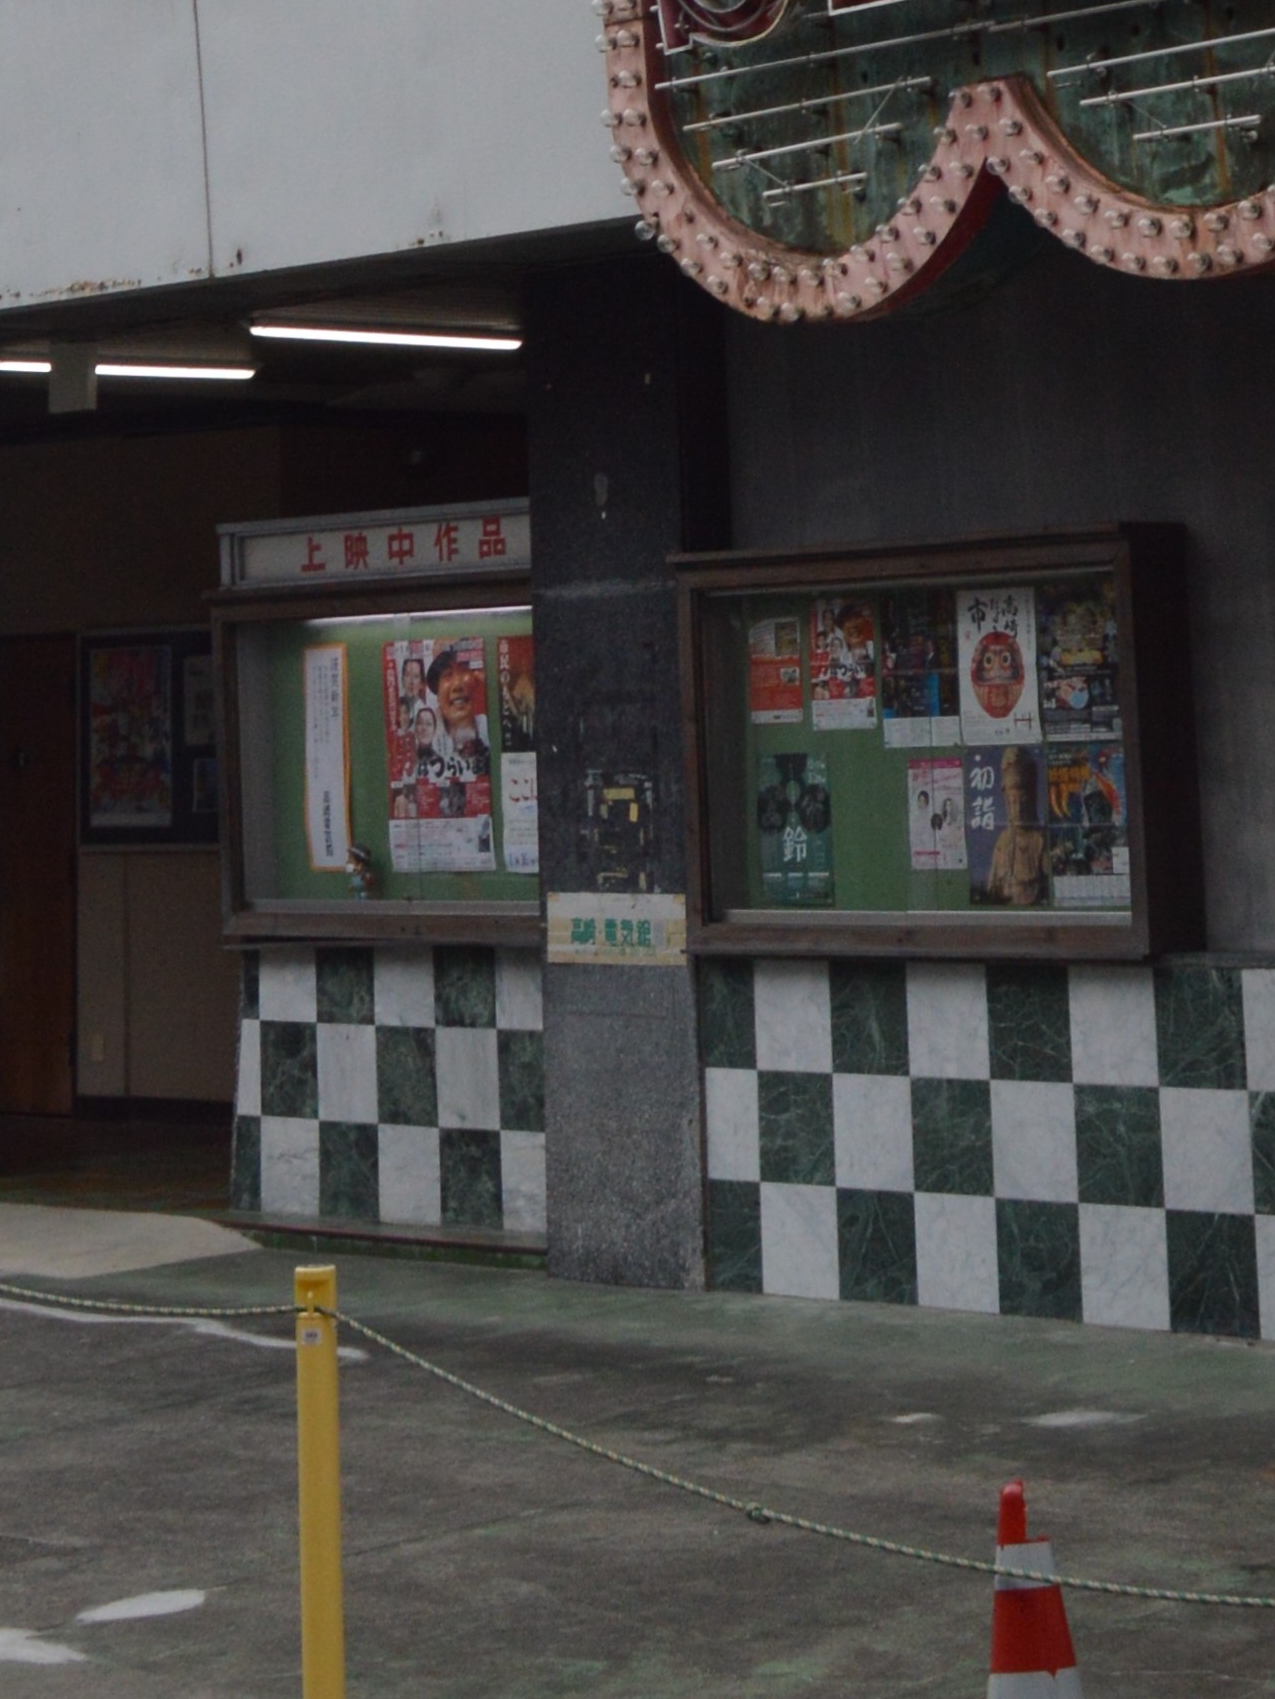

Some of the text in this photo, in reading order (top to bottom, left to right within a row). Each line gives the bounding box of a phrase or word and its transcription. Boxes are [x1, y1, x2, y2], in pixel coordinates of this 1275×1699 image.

[300, 515, 507, 573] 上映中作品
[969, 765, 996, 831] 初詣
[782, 825, 809, 863] 鈴
